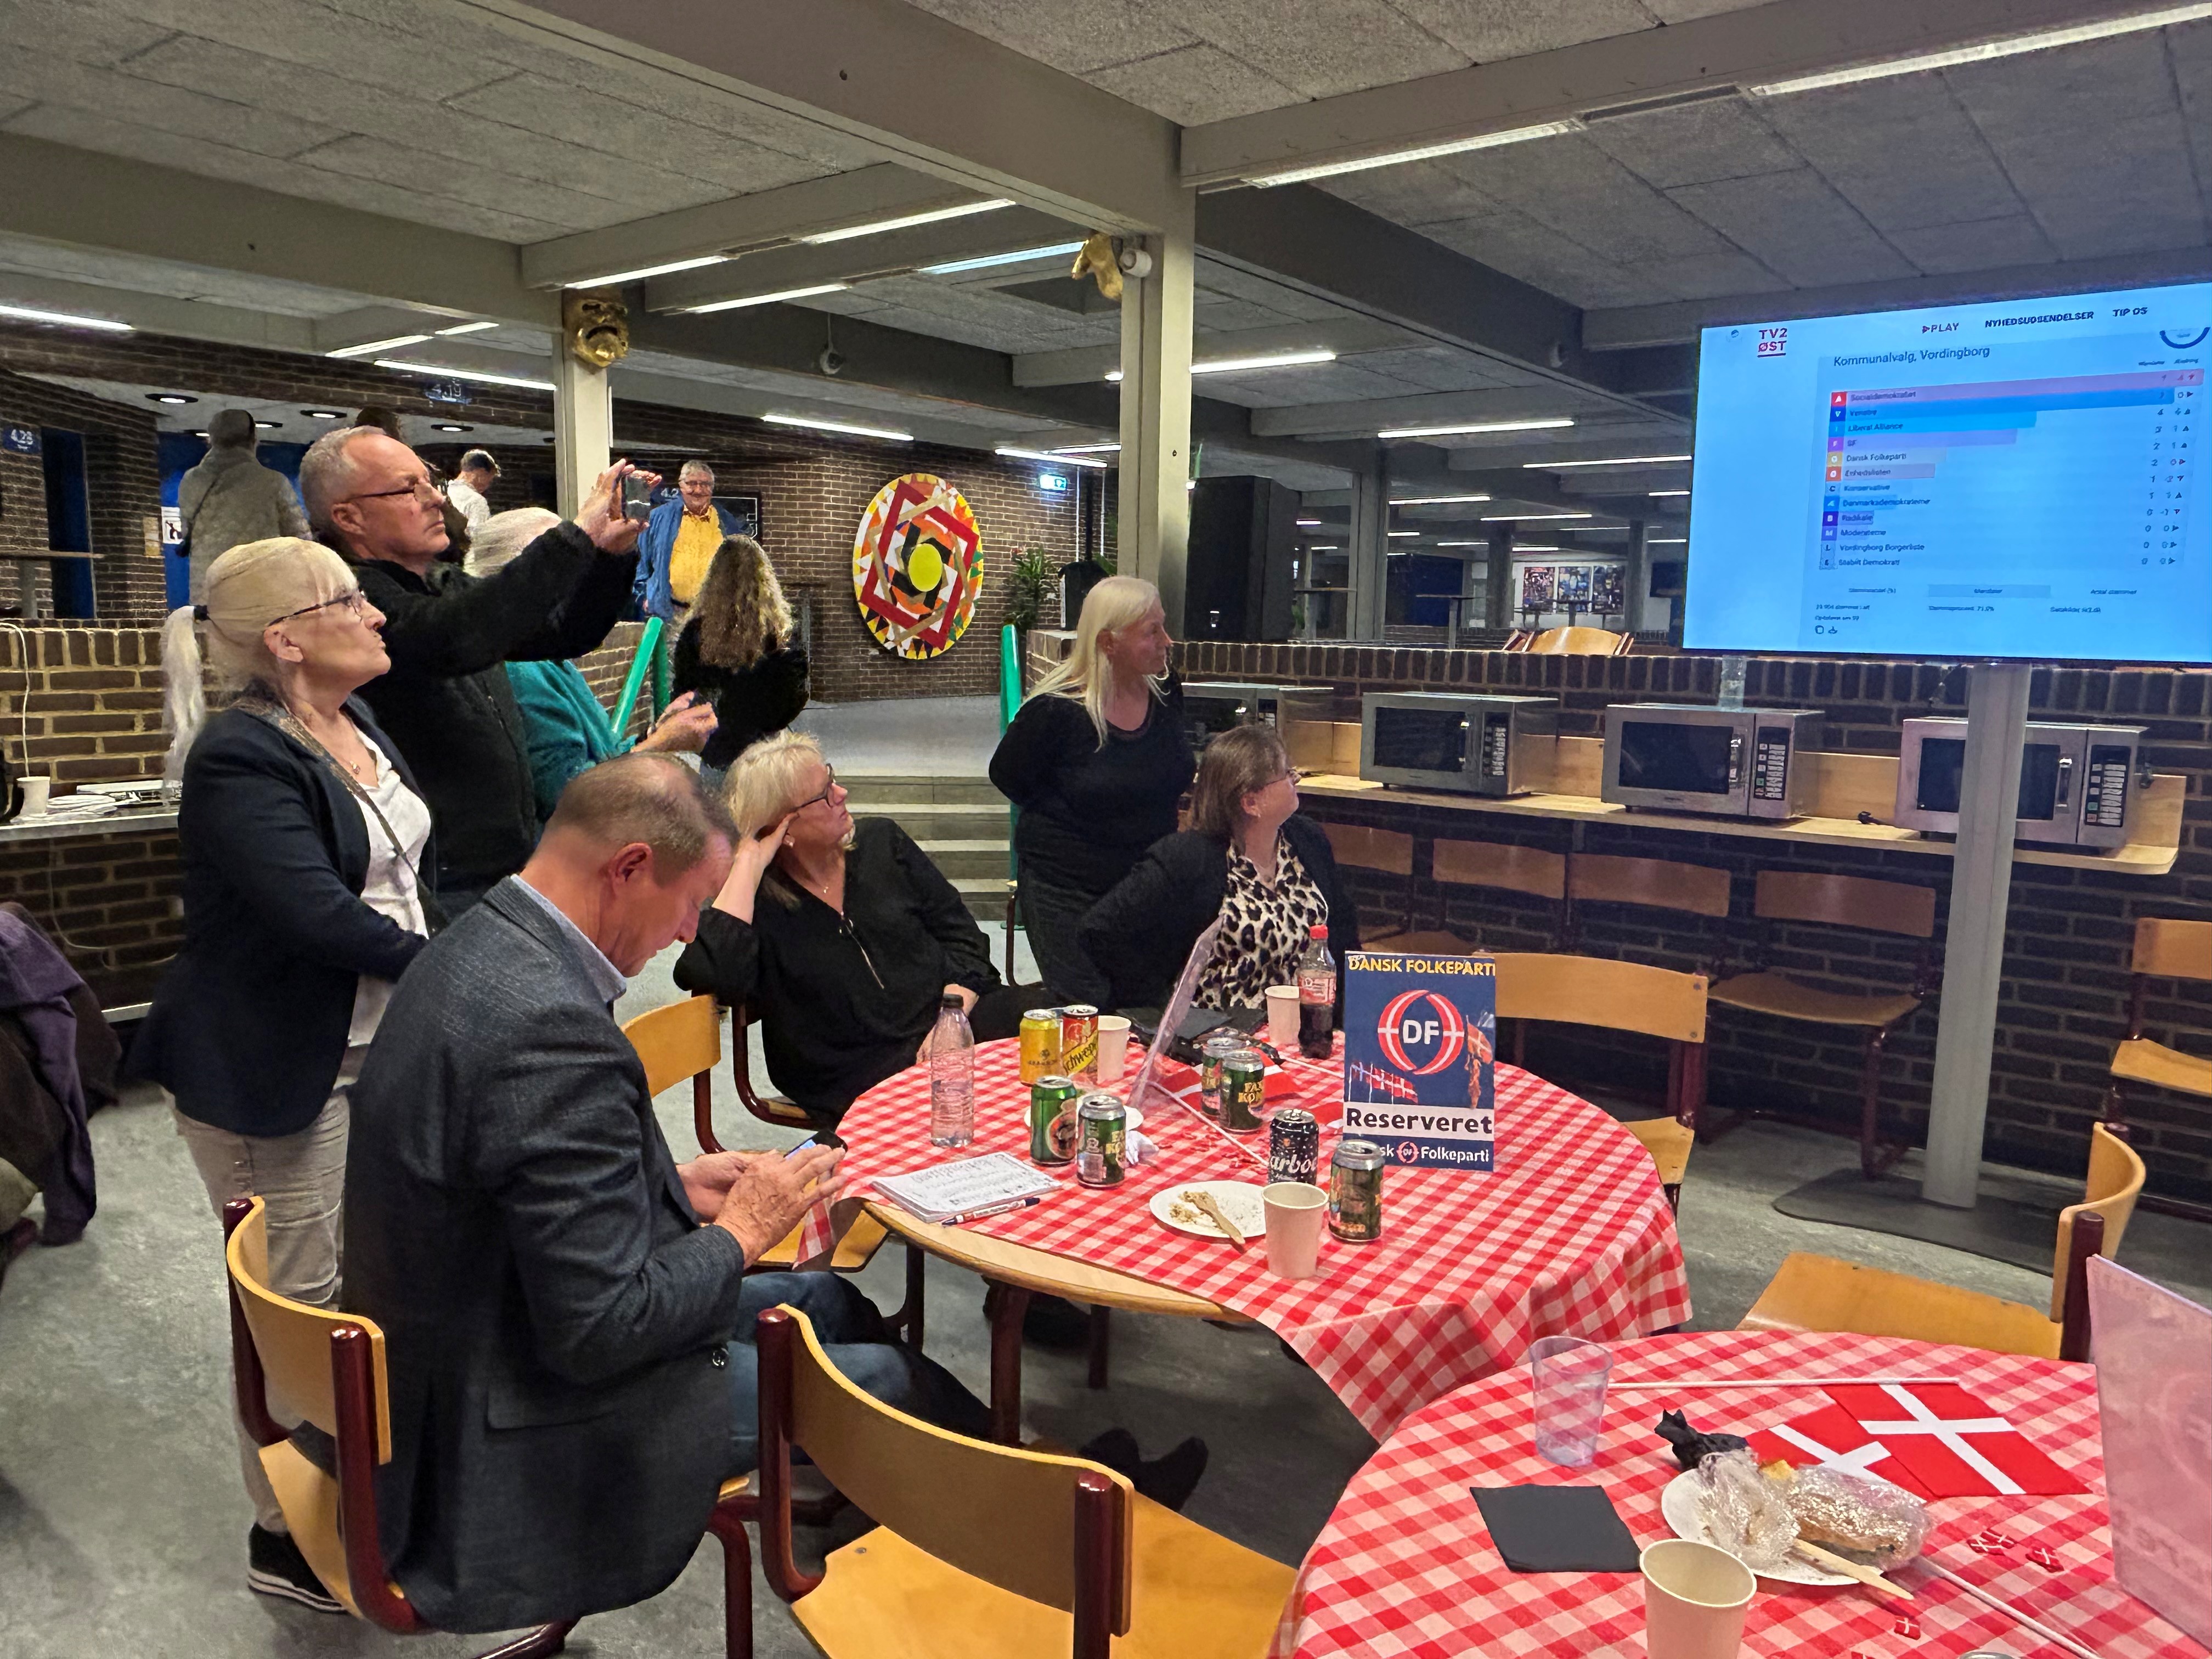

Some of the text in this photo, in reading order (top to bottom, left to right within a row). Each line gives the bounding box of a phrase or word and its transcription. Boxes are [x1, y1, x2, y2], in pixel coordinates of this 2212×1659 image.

[1931, 322, 1959, 332] PLAY
[2112, 308, 2130, 318] TIP
[2133, 306, 2148, 315] OS
[1758, 328, 1787, 339] TV2
[1758, 341, 1786, 352] ØST
[1833, 346, 1990, 366] Kommunalvalg, Vordingborg
[1348, 956, 1496, 977] DANSK FOLKEPARTI
[1402, 1019, 1440, 1045] DF
[1346, 1108, 1493, 1134] Reserveret
[1420, 1146, 1489, 1164] Folkeparti
